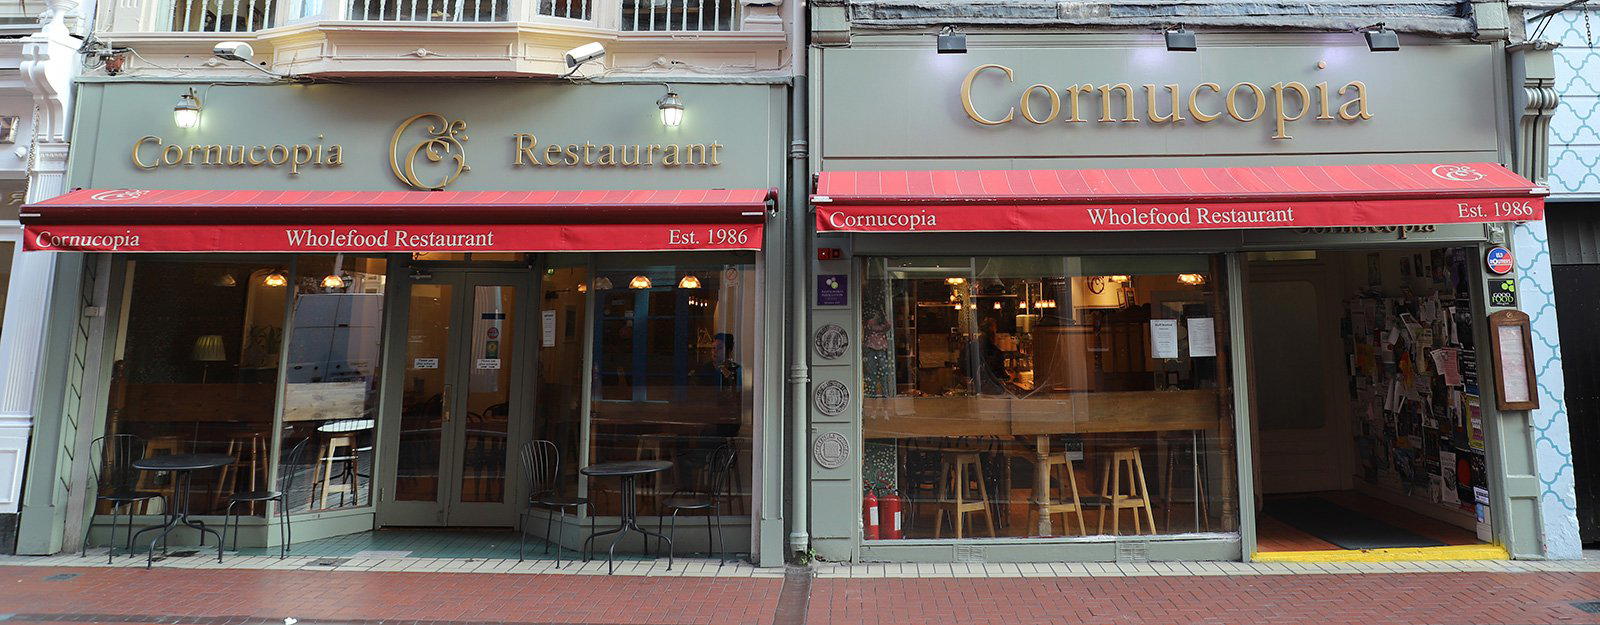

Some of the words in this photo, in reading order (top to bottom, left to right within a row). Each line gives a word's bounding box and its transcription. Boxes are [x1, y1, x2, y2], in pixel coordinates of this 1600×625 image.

[960, 62, 1373, 140] Cornucopia
[132, 134, 344, 174] Cornucopia
[512, 132, 723, 167] Restaurant
[1087, 206, 1191, 226] Wholefood
[1197, 207, 1294, 224] Restaurant
[1458, 202, 1487, 217] Est.
[1494, 200, 1533, 216] 1986
[829, 209, 936, 230] Cornucopia
[36, 230, 140, 251] Cornucopia
[285, 228, 390, 247] Wholefood
[395, 229, 494, 247] Restaurant
[668, 229, 700, 245] Est.
[707, 228, 749, 245] 1986
